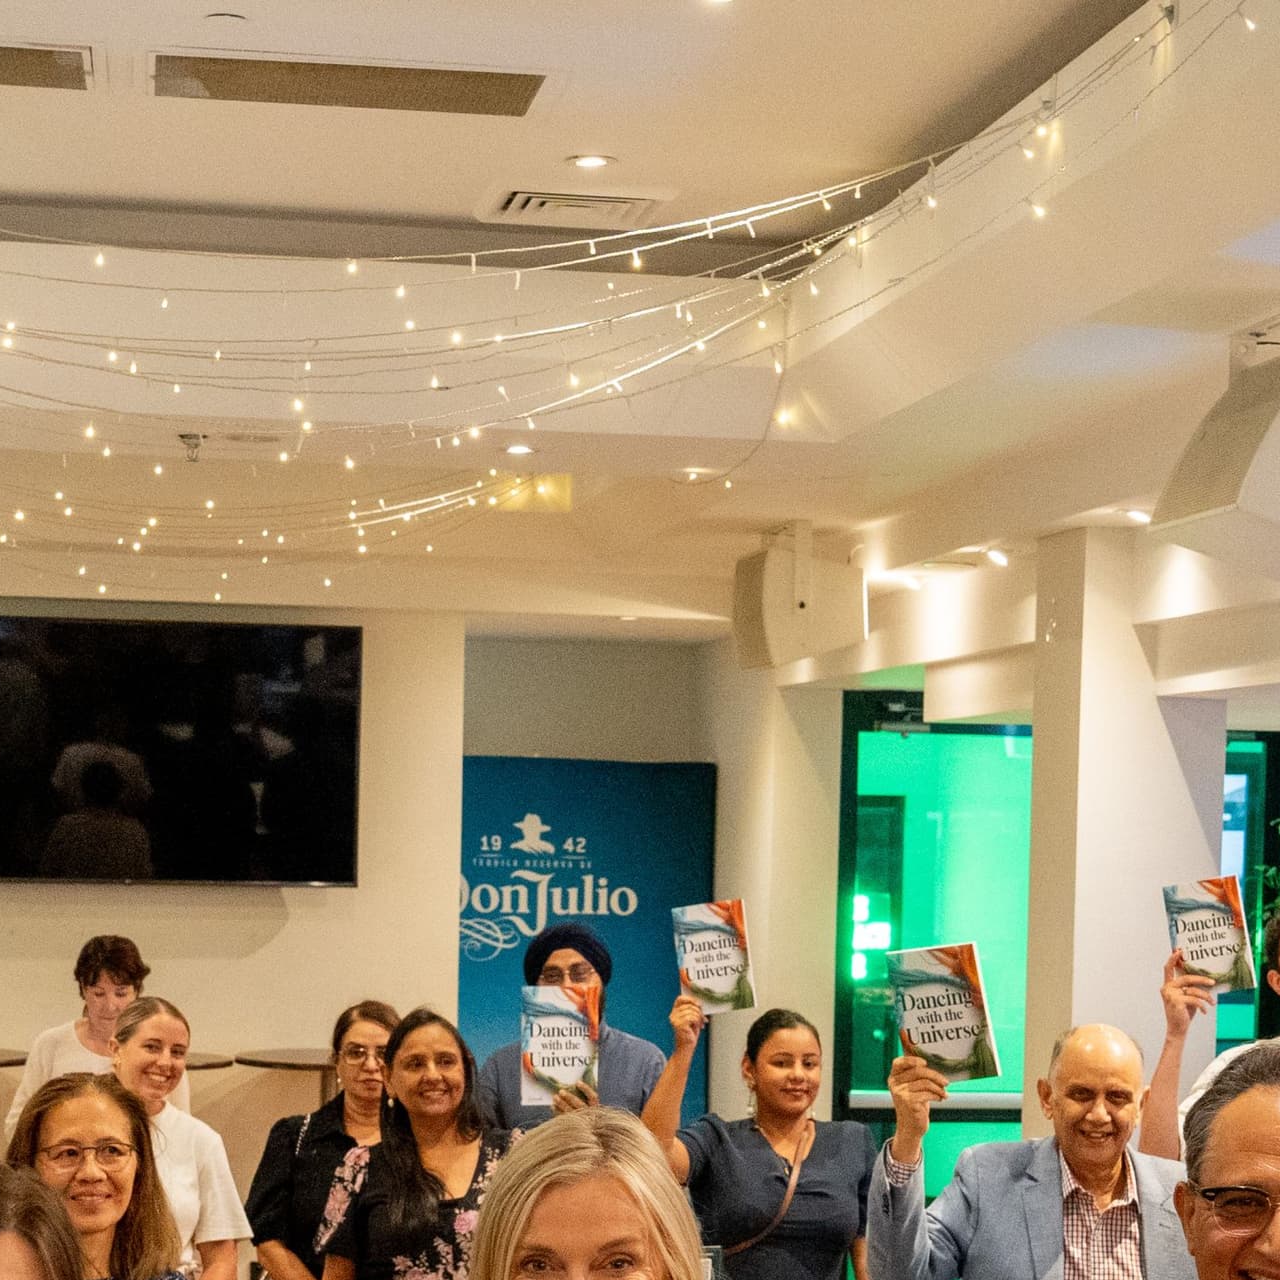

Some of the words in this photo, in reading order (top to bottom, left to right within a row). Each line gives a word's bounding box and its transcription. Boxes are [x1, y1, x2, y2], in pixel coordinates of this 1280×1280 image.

[480, 834, 502, 851] 19
[563, 836, 587, 853] 42
[510, 869, 638, 937] Julio
[1175, 913, 1235, 934] Dancing
[682, 935, 740, 954] Dancing
[1187, 932, 1209, 945] with
[1211, 930, 1227, 941] the
[694, 952, 714, 964] with
[716, 951, 731, 962] the
[686, 963, 745, 981] Universe
[901, 988, 975, 1012] Dancing
[917, 1012, 942, 1025] with
[945, 1009, 963, 1023] the
[529, 1021, 591, 1038] Dancing
[906, 1023, 981, 1046] Universe
[541, 1040, 562, 1051] with
[565, 1040, 580, 1050] the
[529, 1052, 592, 1068] Universe
